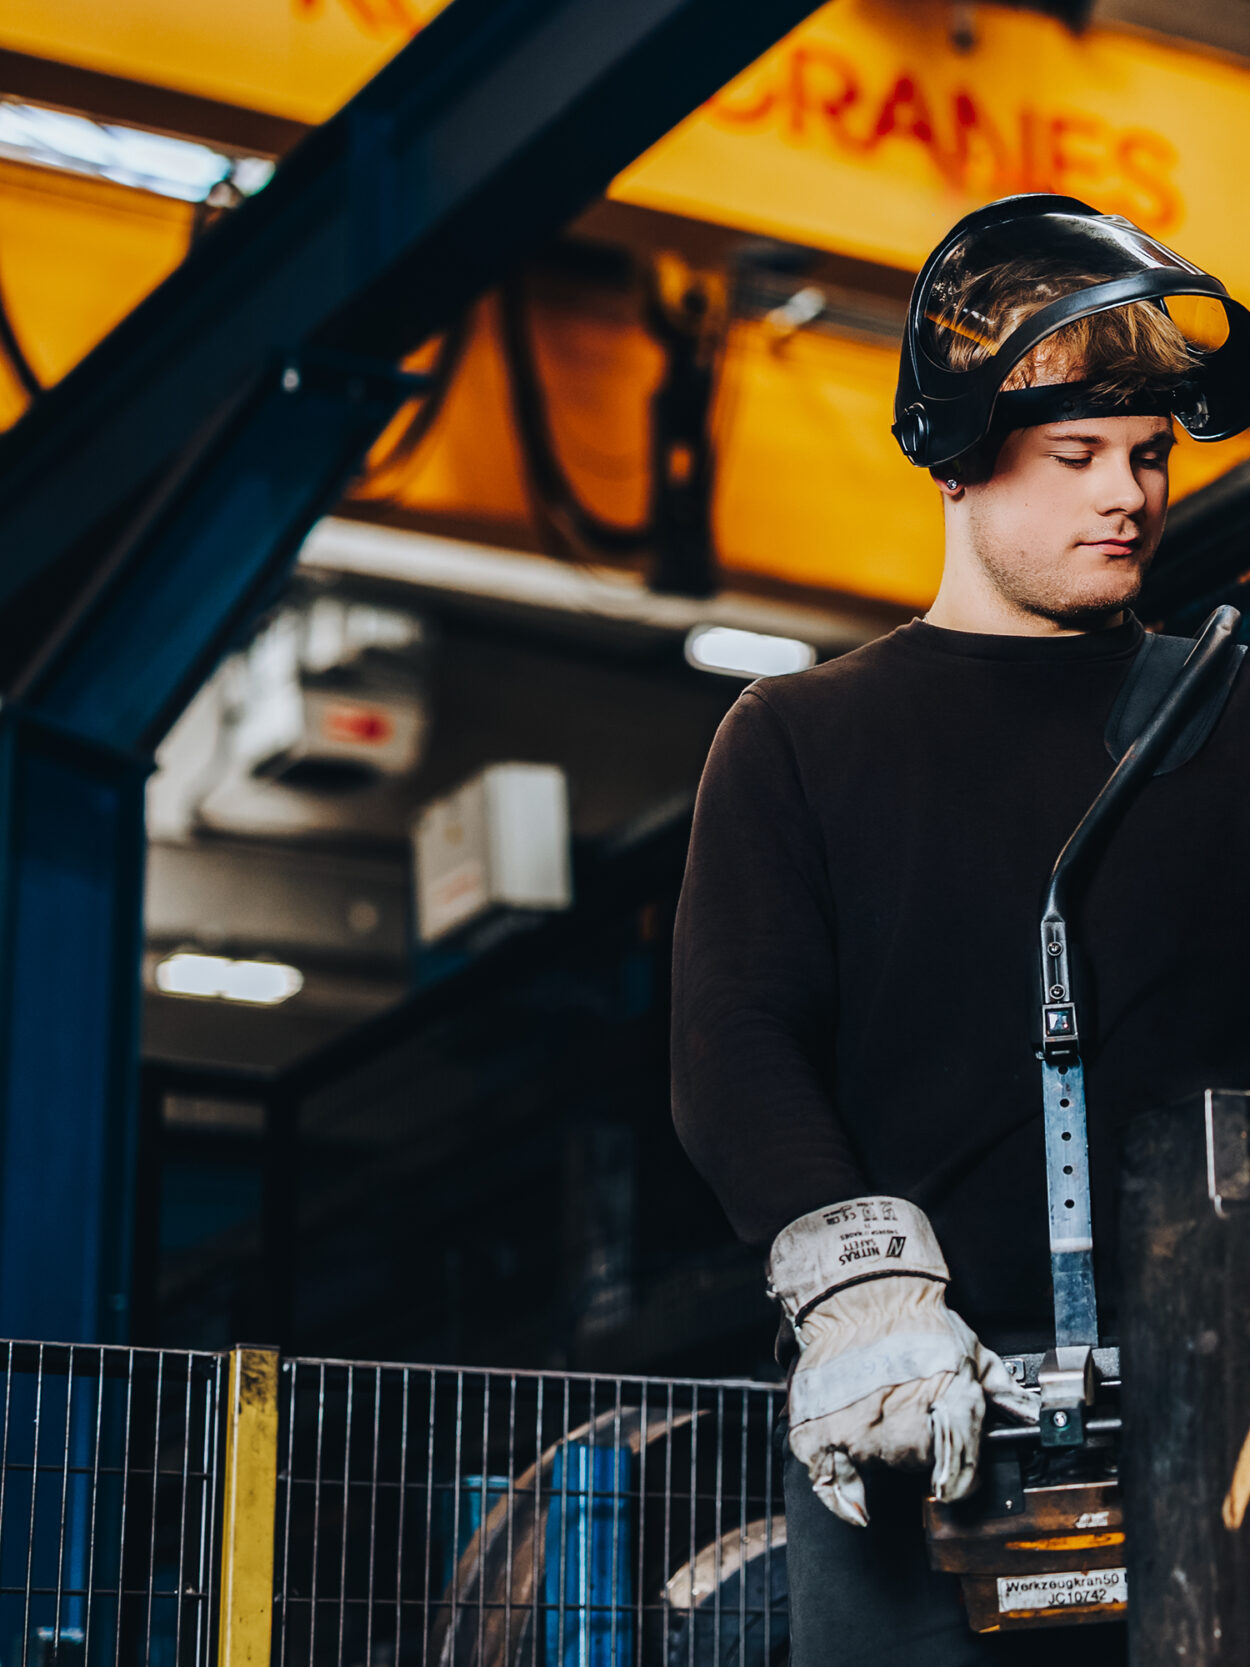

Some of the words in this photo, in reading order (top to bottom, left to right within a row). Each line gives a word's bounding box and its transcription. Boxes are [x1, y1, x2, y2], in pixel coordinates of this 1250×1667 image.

[843, 1238, 877, 1252] SAFETY
[839, 1246, 880, 1266] NITRAS
[1006, 1573, 1119, 1593] Werkzeugkran50
[1048, 1589, 1107, 1606] JC10742
